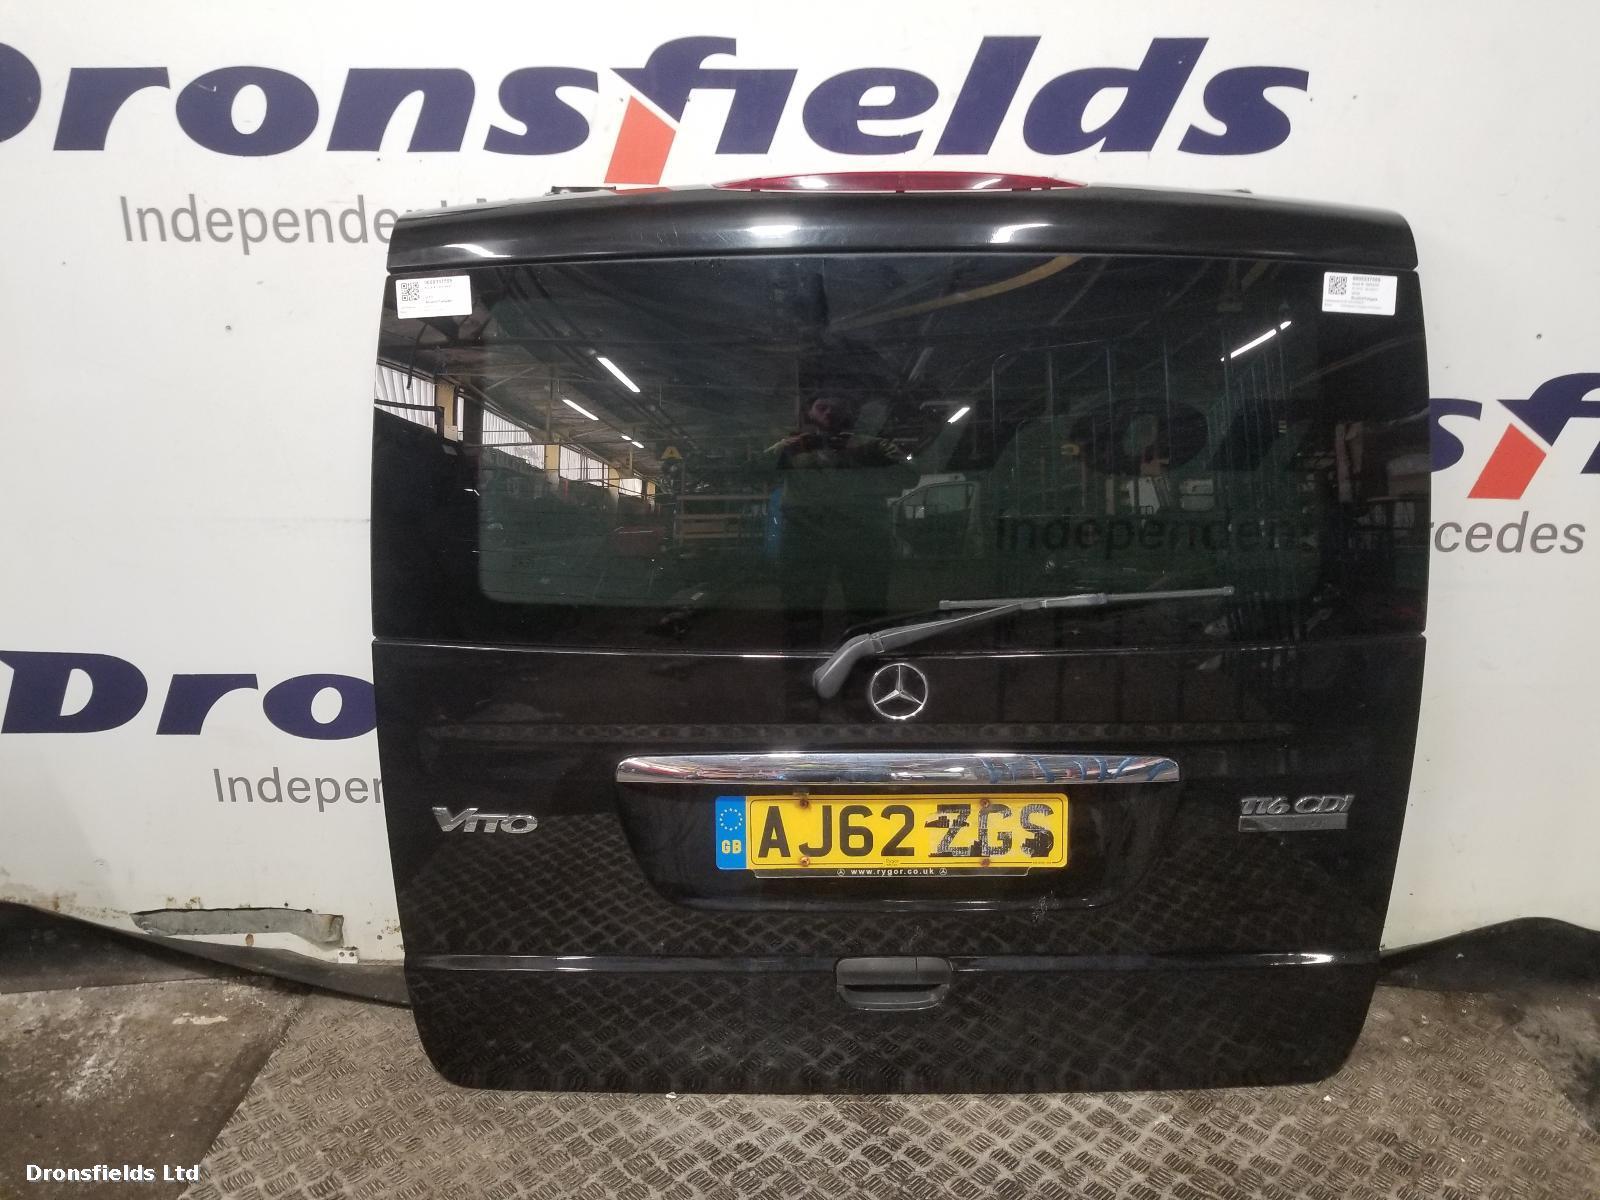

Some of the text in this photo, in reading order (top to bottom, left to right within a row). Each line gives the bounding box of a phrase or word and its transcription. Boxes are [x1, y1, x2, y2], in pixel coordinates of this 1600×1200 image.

[0, 35, 1309, 186] ronsfields
[1430, 510, 1586, 554] cedes
[1240, 795, 1355, 815] 116 CDI
[721, 839, 743, 855] GB
[757, 804, 915, 859] AJ62
[850, 868, 935, 877] www.rygor.co.uk
